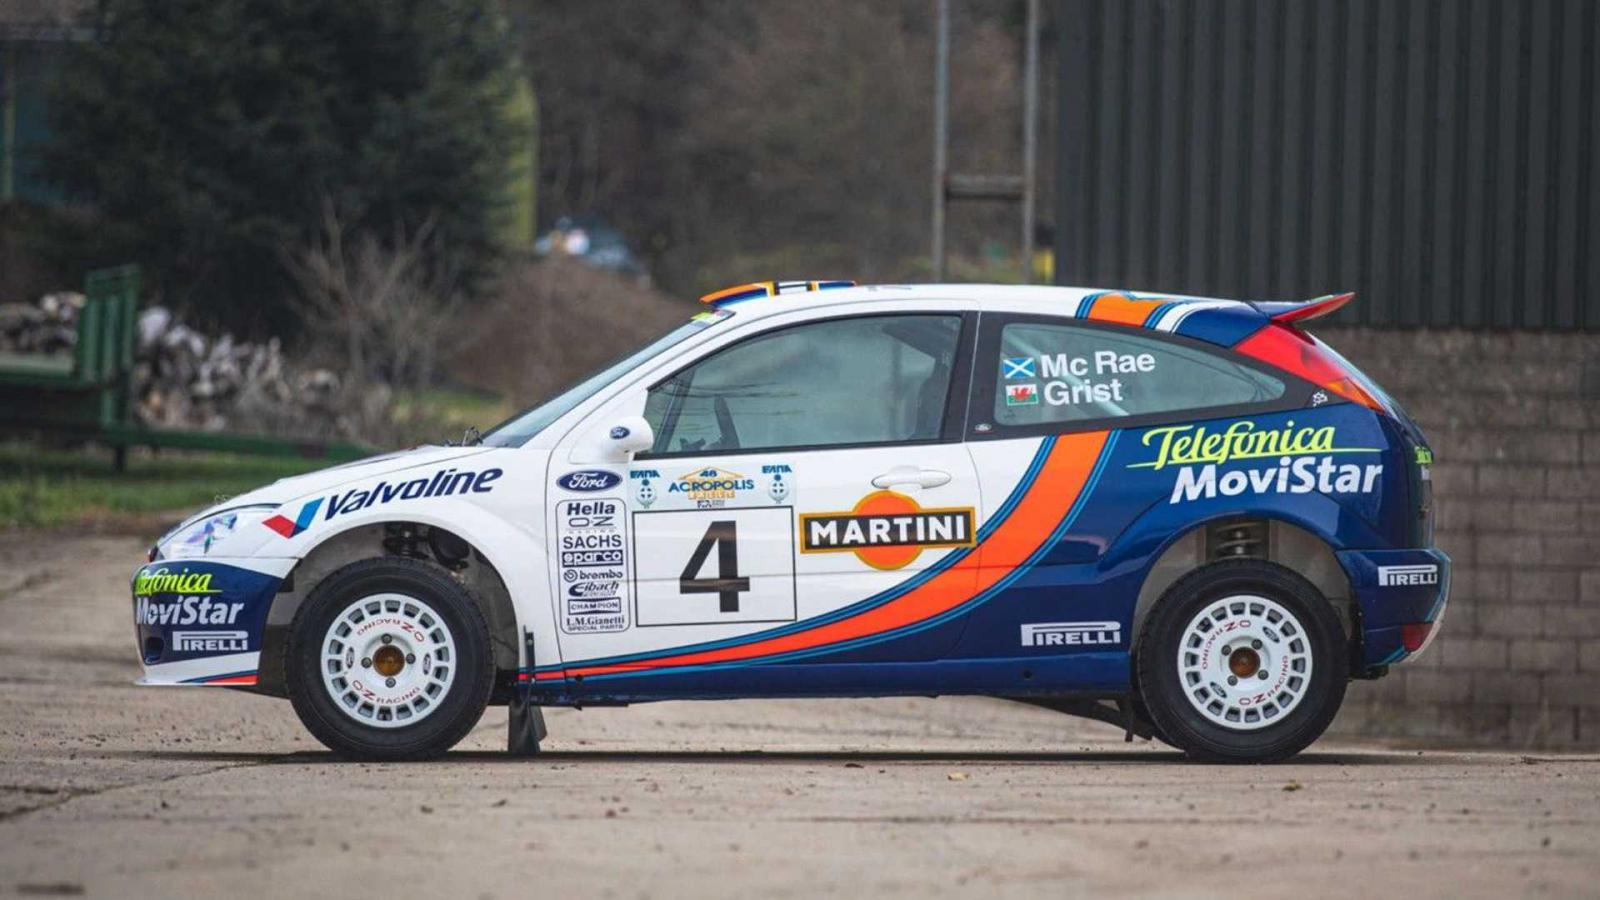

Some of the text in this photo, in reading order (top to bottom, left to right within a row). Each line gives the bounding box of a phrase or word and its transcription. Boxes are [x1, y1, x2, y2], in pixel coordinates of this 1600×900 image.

[1041, 351, 1155, 378] Mc Rae
[1044, 379, 1123, 405] Grist
[568, 472, 608, 488] Ford
[668, 480, 754, 493] ACROPOLIS
[1170, 456, 1383, 504] MoviStar
[325, 468, 503, 521] Valvoline
[567, 502, 615, 515] Hella
[563, 535, 622, 549] SACHS
[810, 515, 966, 546] MARTINI
[580, 569, 623, 579] brembo
[680, 521, 750, 612] 4
[1378, 565, 1437, 586] PIRELLI
[136, 595, 244, 625] MoviStar
[571, 601, 618, 609] CHAMPION
[172, 631, 248, 651] PIRELLI
[1021, 621, 1121, 646] PIRELLI
